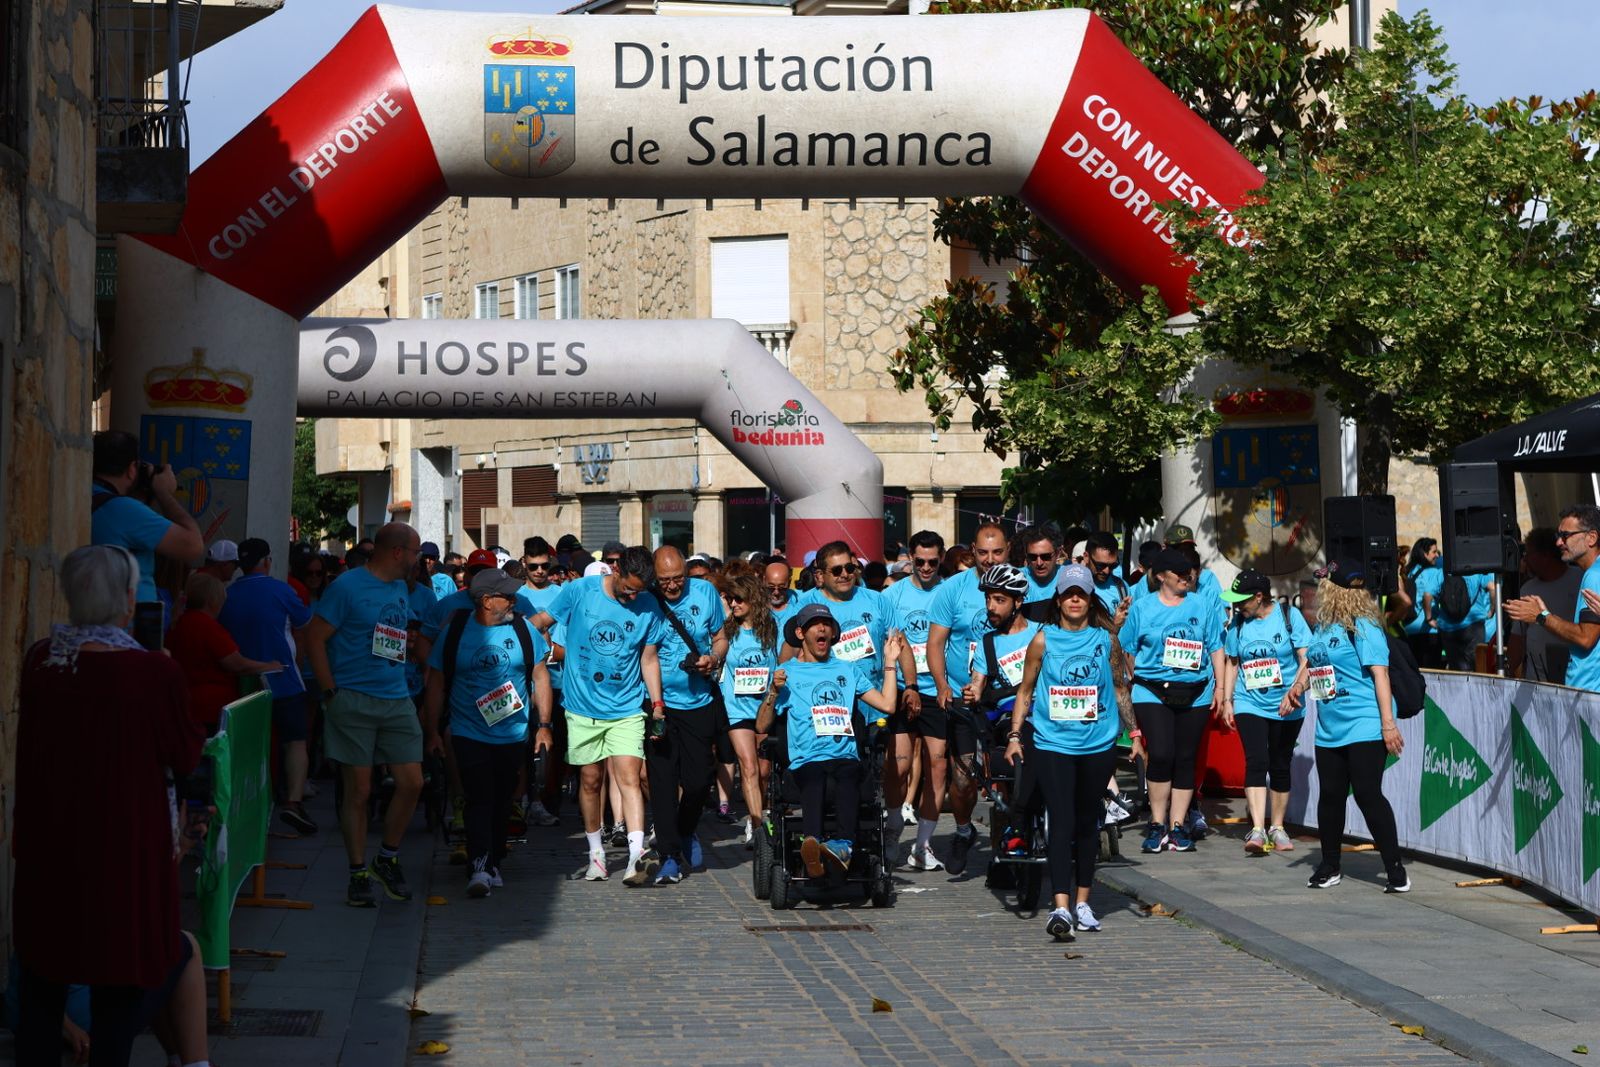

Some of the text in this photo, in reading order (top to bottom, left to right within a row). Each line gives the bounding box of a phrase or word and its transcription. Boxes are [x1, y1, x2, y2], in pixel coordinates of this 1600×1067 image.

[614, 41, 933, 104] Diputación
[1083, 94, 1141, 151] CON
[610, 114, 992, 166] de Salamanca
[208, 91, 403, 260] CON EL DEPORTE
[397, 341, 588, 376] HOSPES
[327, 390, 657, 409] PALACIO DE SAN ESTEBAN
[730, 409, 820, 426] floristería
[732, 427, 825, 446] bedunia
[1513, 435, 1530, 457] LA
[910, 620, 928, 631] XII
[598, 630, 616, 642] XII
[379, 637, 402, 652] 1282
[843, 638, 865, 653] 604
[1166, 639, 1202, 650] bedunia
[744, 654, 762, 666] XII
[1171, 648, 1197, 661] 1174
[1242, 658, 1278, 670] bedunia
[1069, 664, 1090, 682] XII
[1253, 668, 1273, 680] 648
[741, 677, 764, 686] 1273
[477, 683, 513, 707] bedunia
[1050, 687, 1097, 696] bedunia
[487, 693, 513, 713] 1267
[1062, 698, 1086, 710] 981
[812, 707, 849, 716] bedunia
[820, 715, 847, 727] 1501
